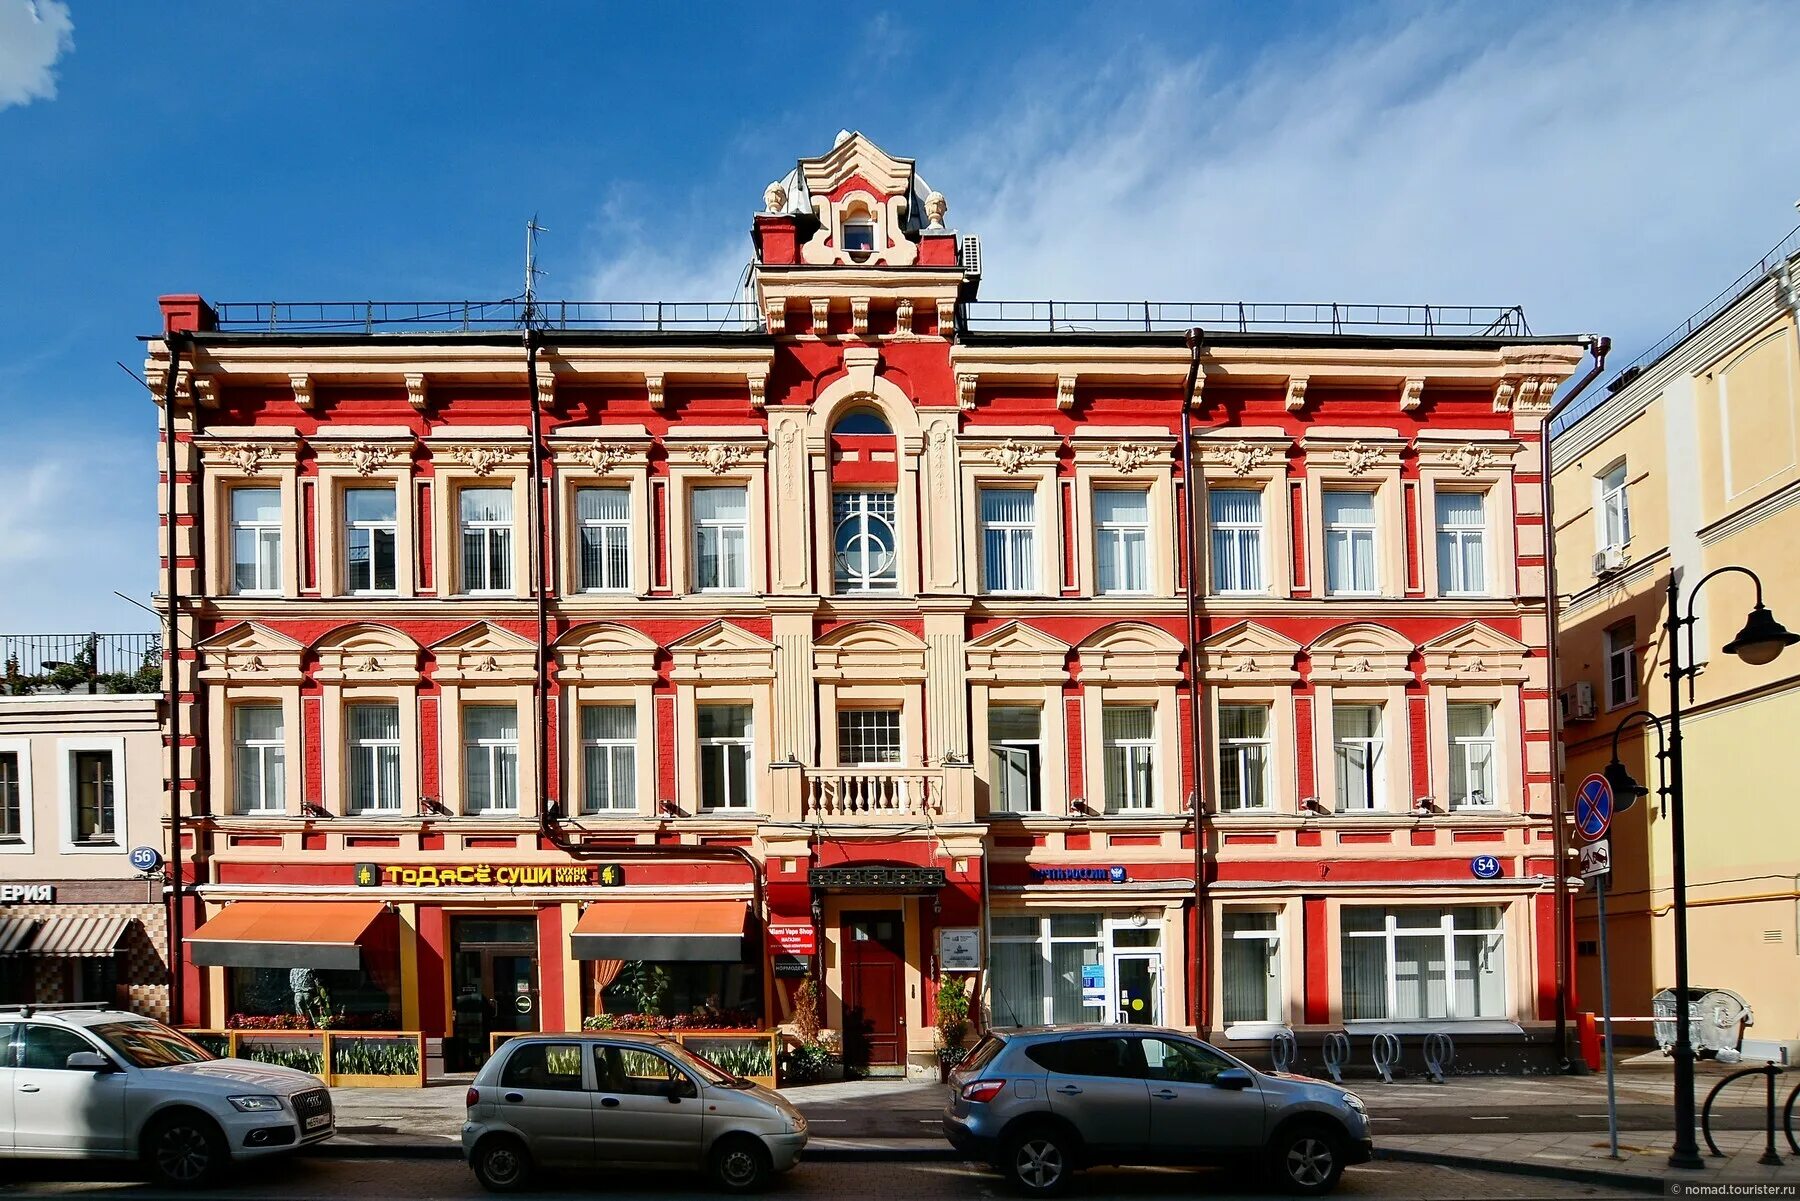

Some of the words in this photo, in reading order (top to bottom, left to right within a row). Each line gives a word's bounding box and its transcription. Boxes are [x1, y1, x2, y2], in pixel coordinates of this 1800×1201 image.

[134, 850, 151, 863] 56
[1478, 859, 1495, 870] 54
[496, 866, 552, 884] СУШИ
[555, 867, 587, 875] КУХНИ
[555, 875, 587, 883] МИРА
[0, 884, 52, 901] ЕРИЯ
[799, 928, 814, 936] Shop
